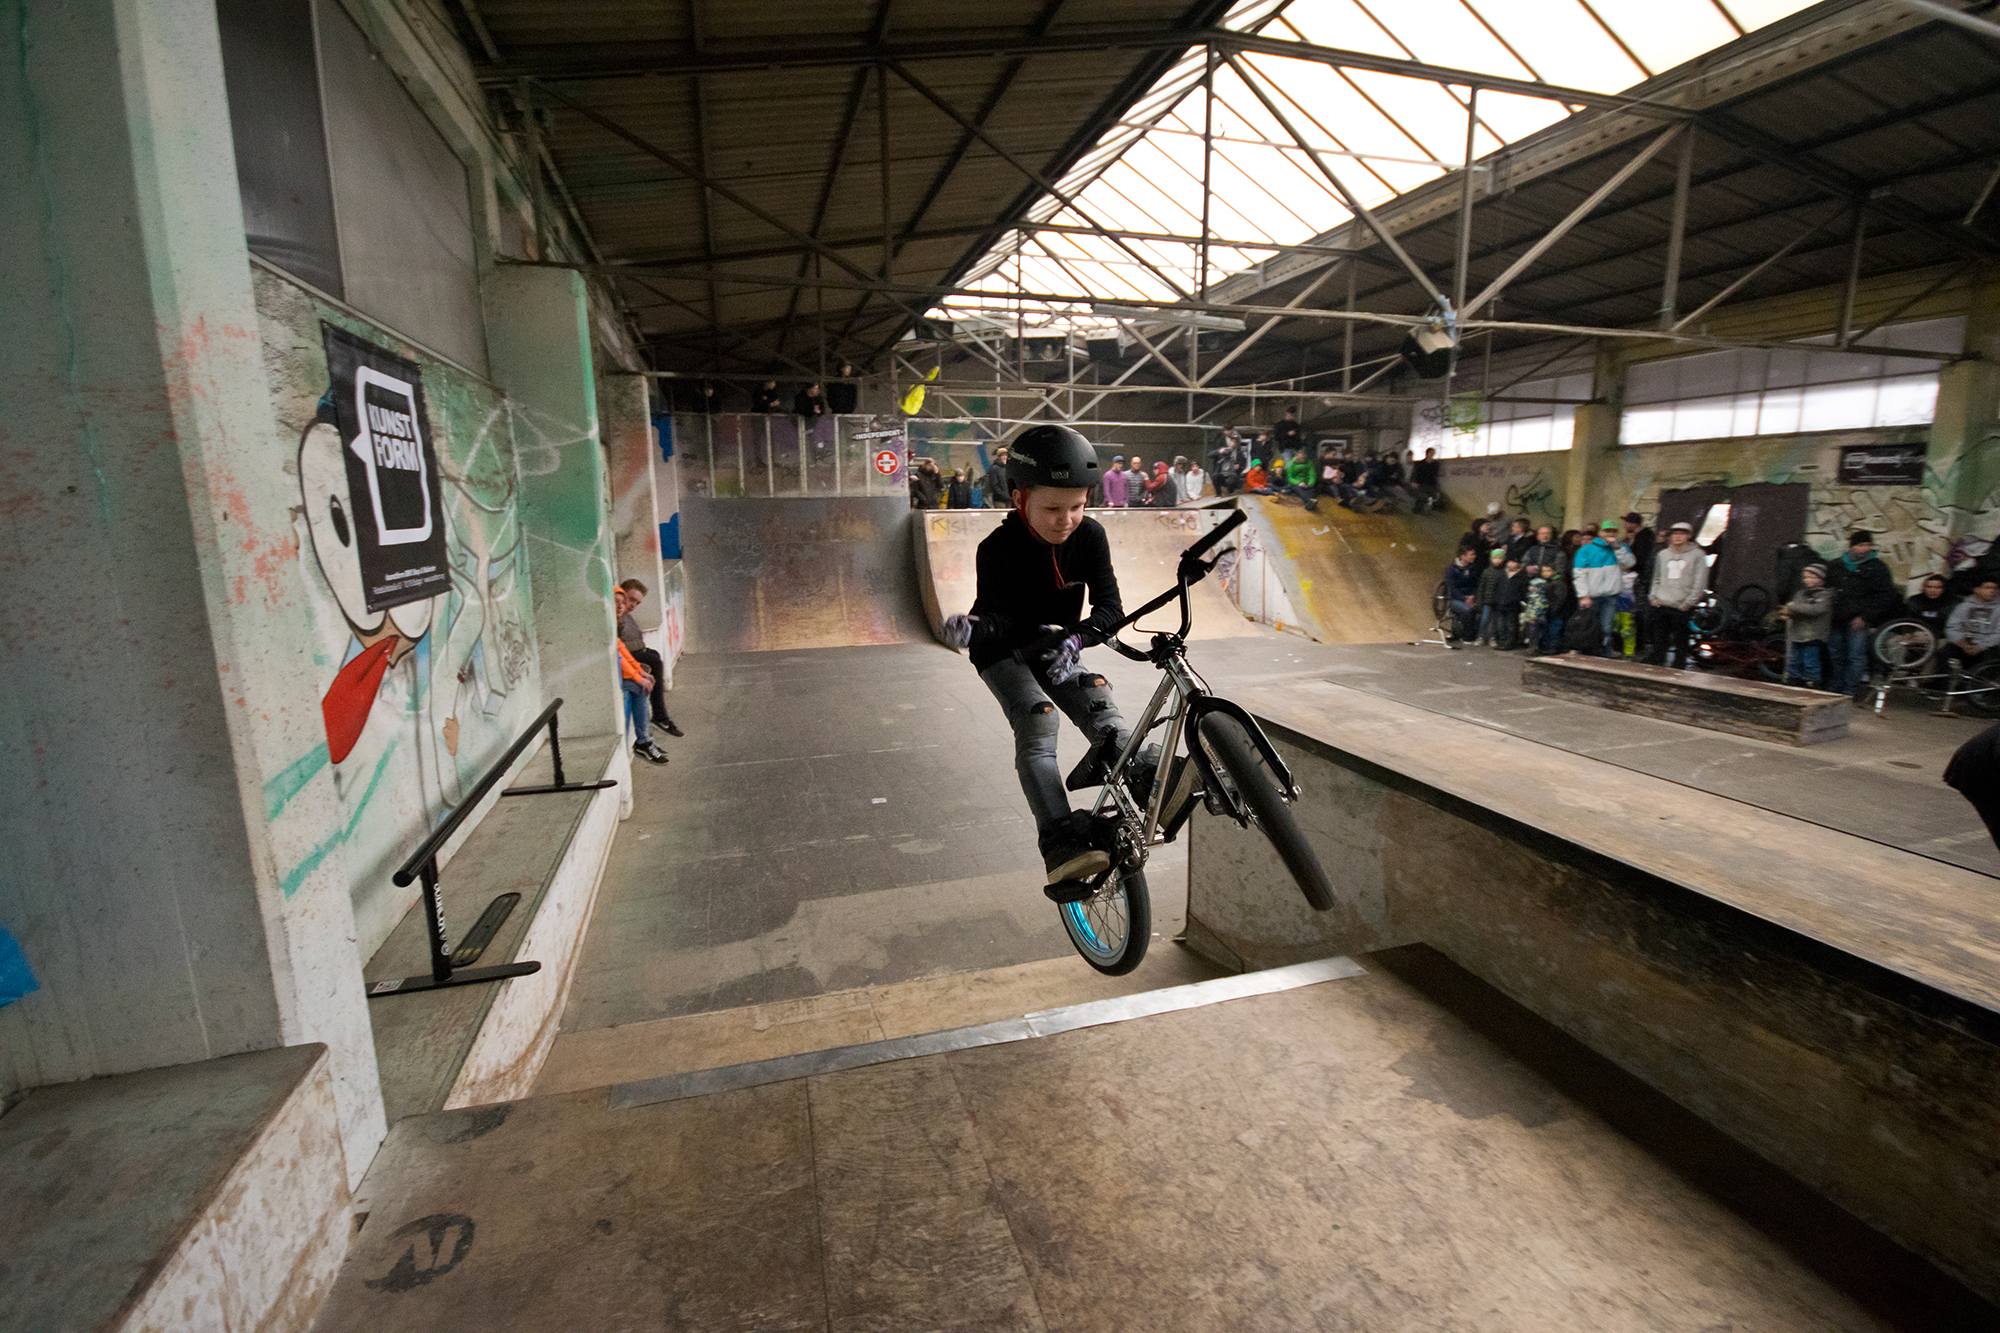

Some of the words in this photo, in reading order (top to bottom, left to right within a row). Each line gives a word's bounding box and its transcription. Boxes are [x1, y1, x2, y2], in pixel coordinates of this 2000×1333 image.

[368, 403, 412, 438] KUNST
[855, 429, 901, 440] INDEPENDENT
[373, 433, 419, 471] FORM
